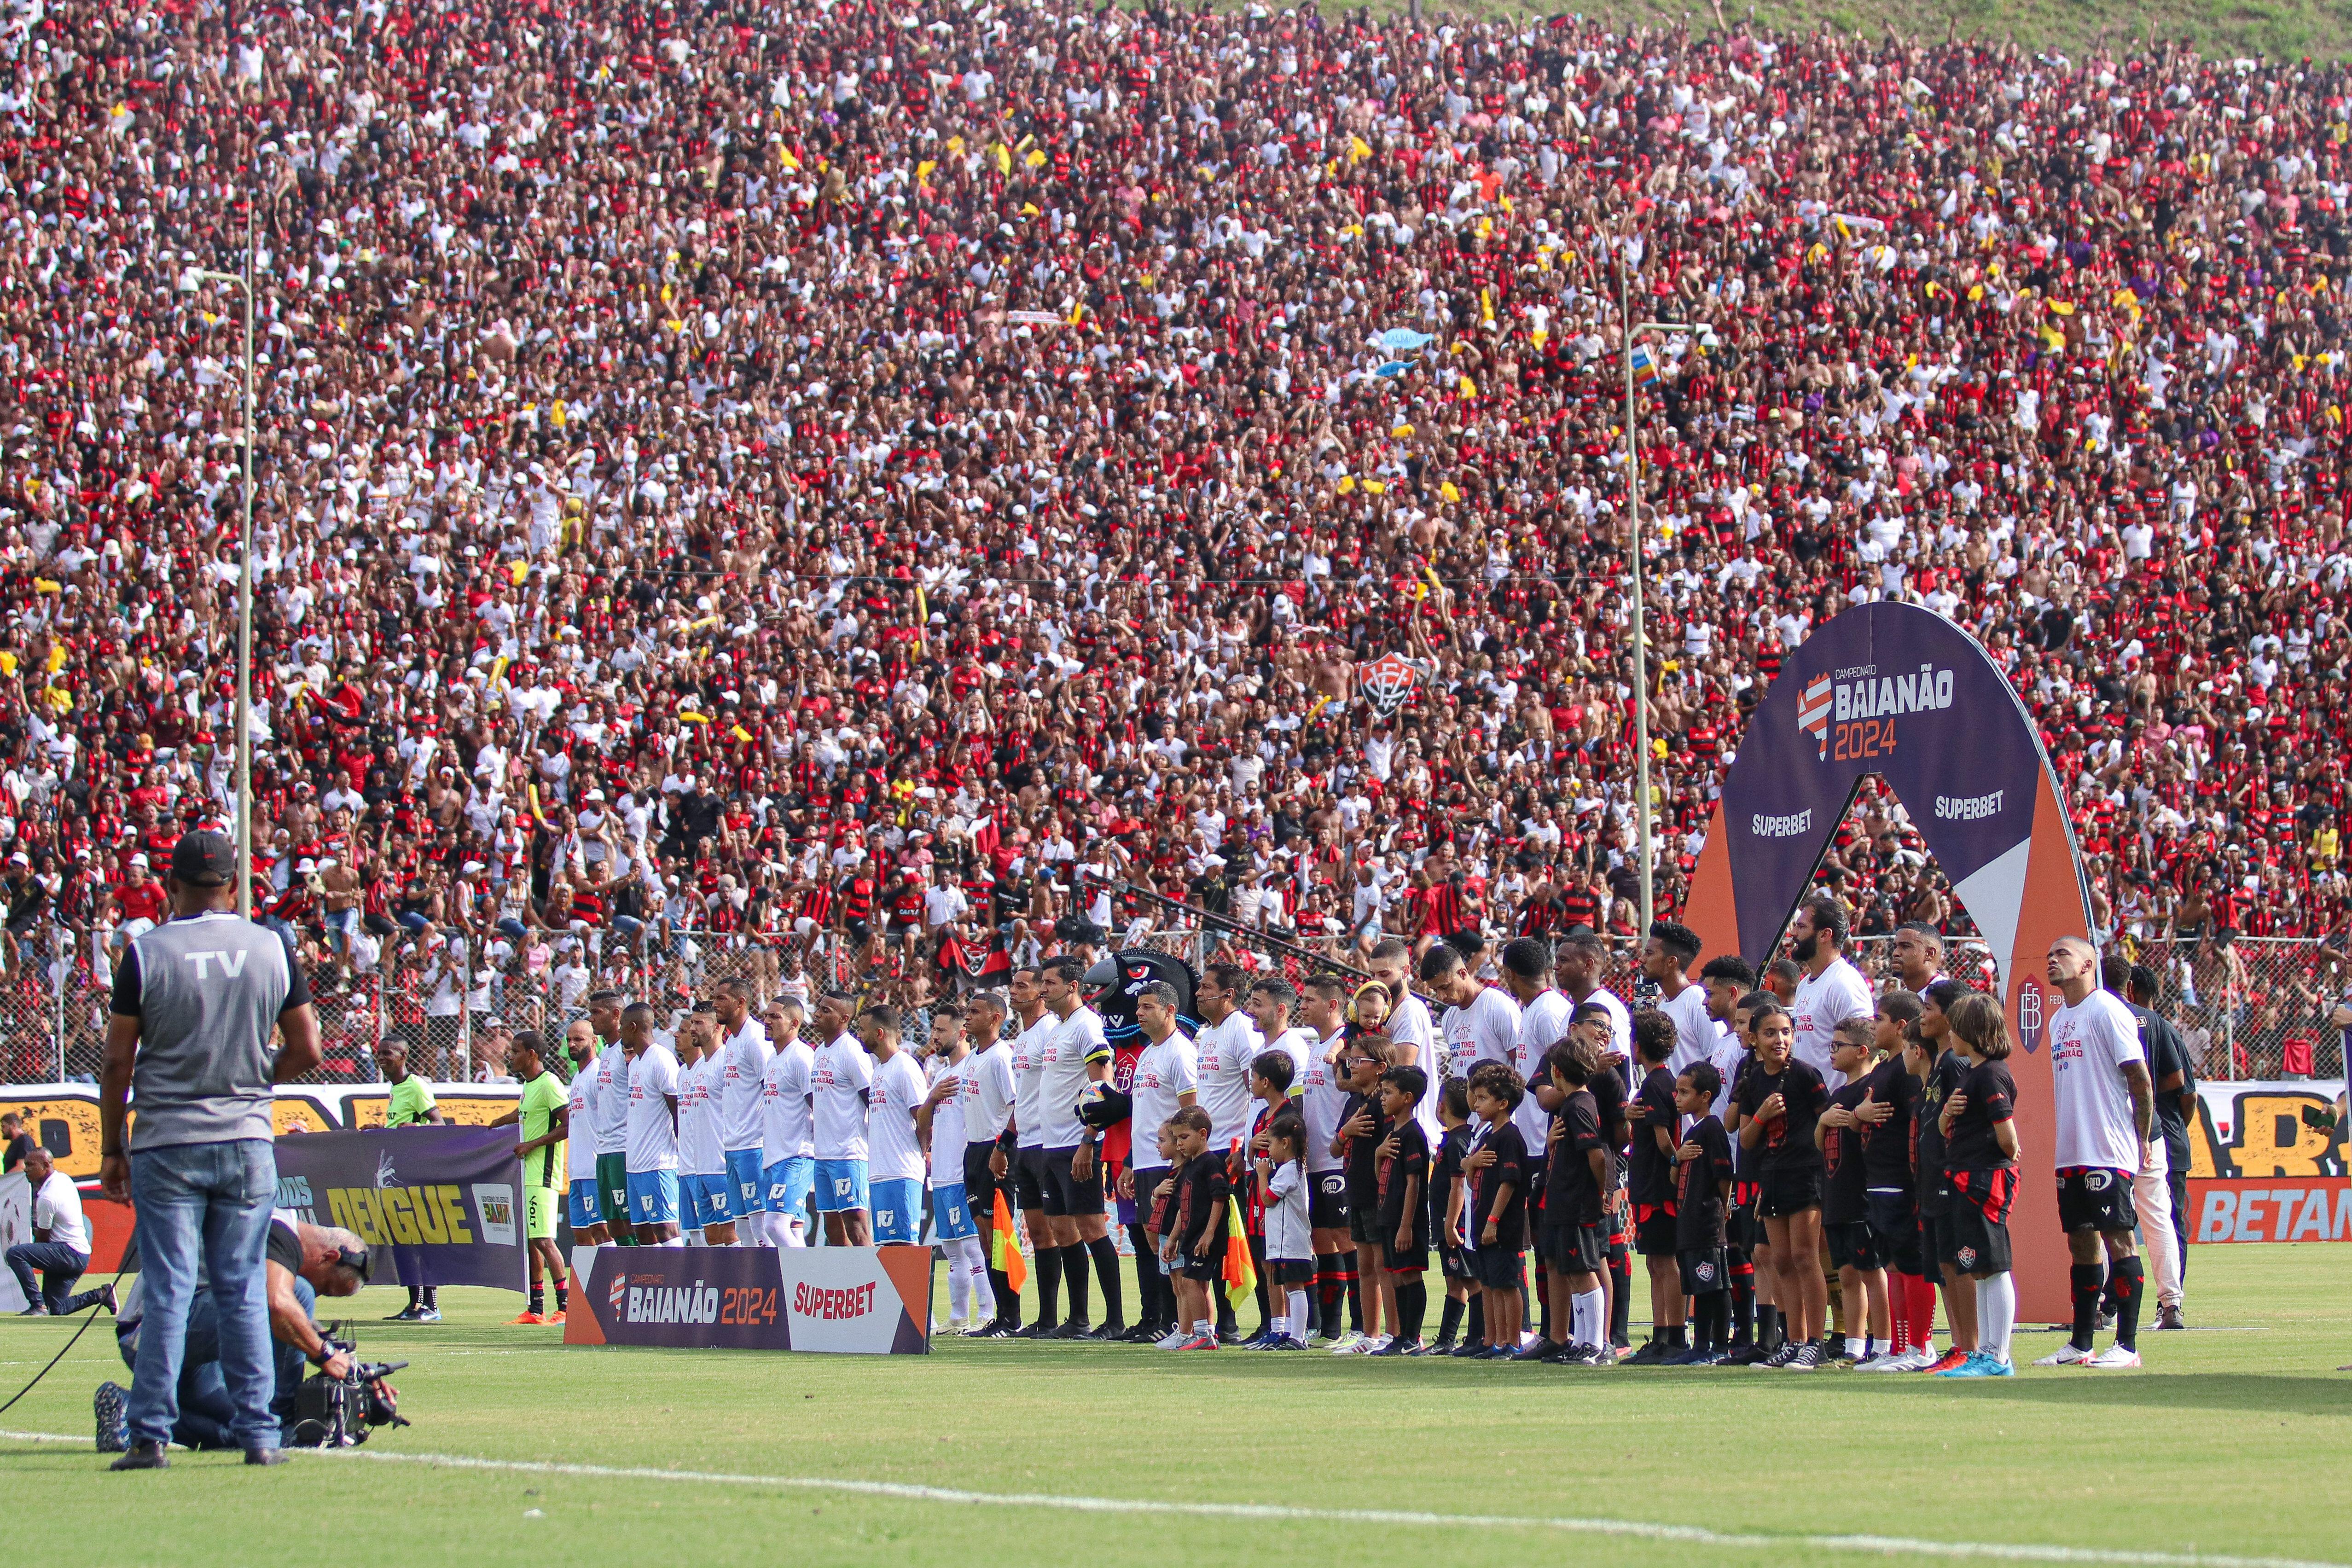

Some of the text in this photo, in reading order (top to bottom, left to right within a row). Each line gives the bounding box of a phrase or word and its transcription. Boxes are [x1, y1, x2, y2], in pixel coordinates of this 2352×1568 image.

[1835, 664, 1876, 680] CAMPEONATO
[1835, 663, 1954, 721] BAIANÃO
[1835, 718, 1897, 761] 2024
[1935, 789, 2004, 820] SUPERBET
[1752, 808, 1812, 837] SUPERBET
[185, 949, 249, 980] TV
[326, 1185, 473, 1246] DENGUE
[631, 1274, 664, 1284] CAMPEONATO
[627, 1279, 777, 1325] BAIANÃO 2024
[794, 1281, 876, 1320] SUPERBET
